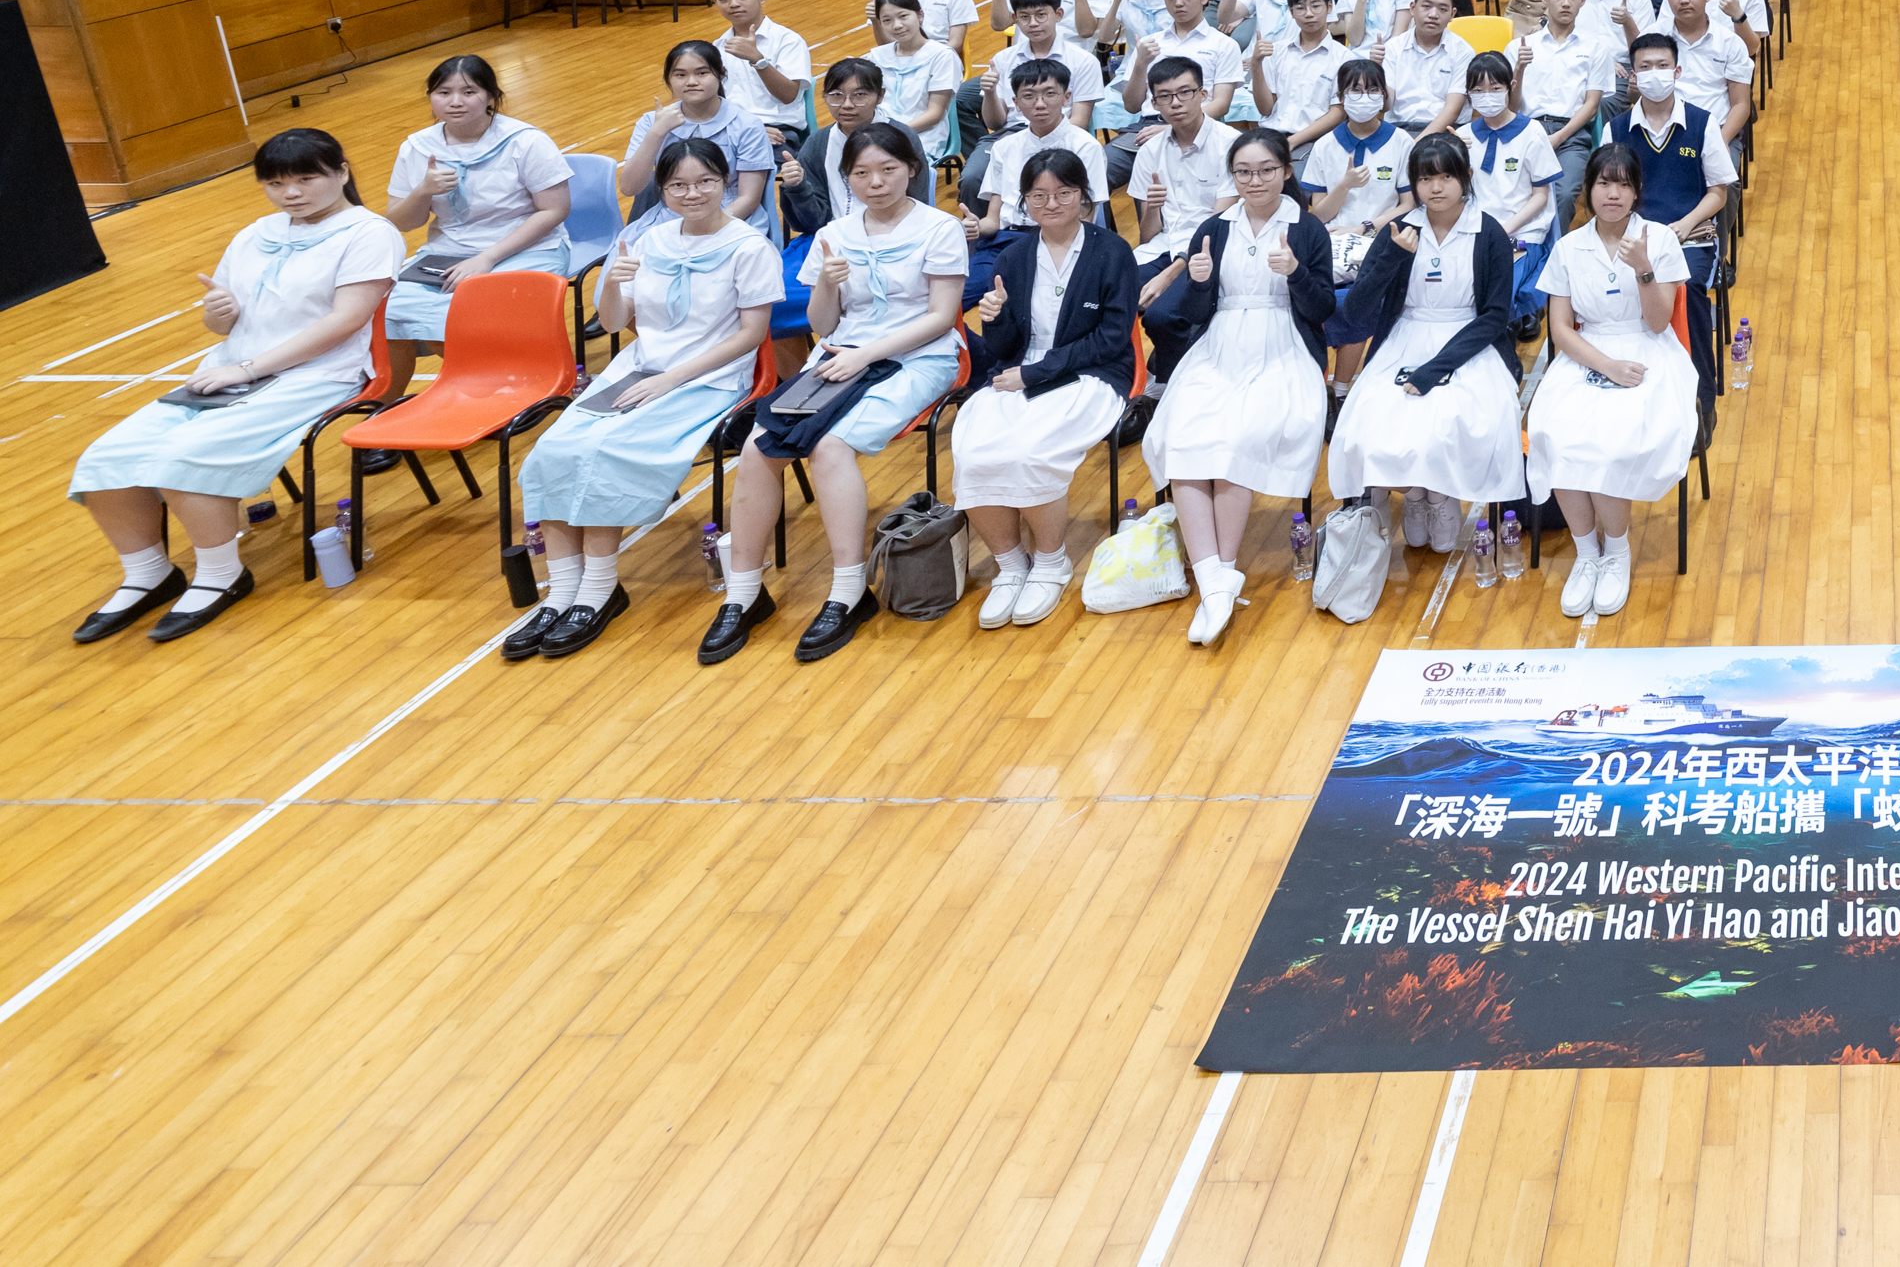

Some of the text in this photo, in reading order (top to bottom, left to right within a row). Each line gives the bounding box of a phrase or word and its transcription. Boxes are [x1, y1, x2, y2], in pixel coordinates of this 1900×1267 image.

[1679, 147, 1696, 158] SFS
[1439, 698, 1468, 706] support
[1503, 697, 1523, 705] Hong
[1524, 697, 1543, 705] Kong
[1504, 861, 1589, 897] 2024
[1598, 860, 1725, 895] Western
[1734, 854, 1836, 893] Pacific
[1339, 904, 1398, 946] The
[1408, 903, 1511, 945] Vessel
[1513, 901, 1594, 943] Shen
[1602, 900, 1656, 941] Hai
[1665, 899, 1696, 940] Yi
[1701, 902, 1762, 939] Hao
[1770, 896, 1829, 938] and
